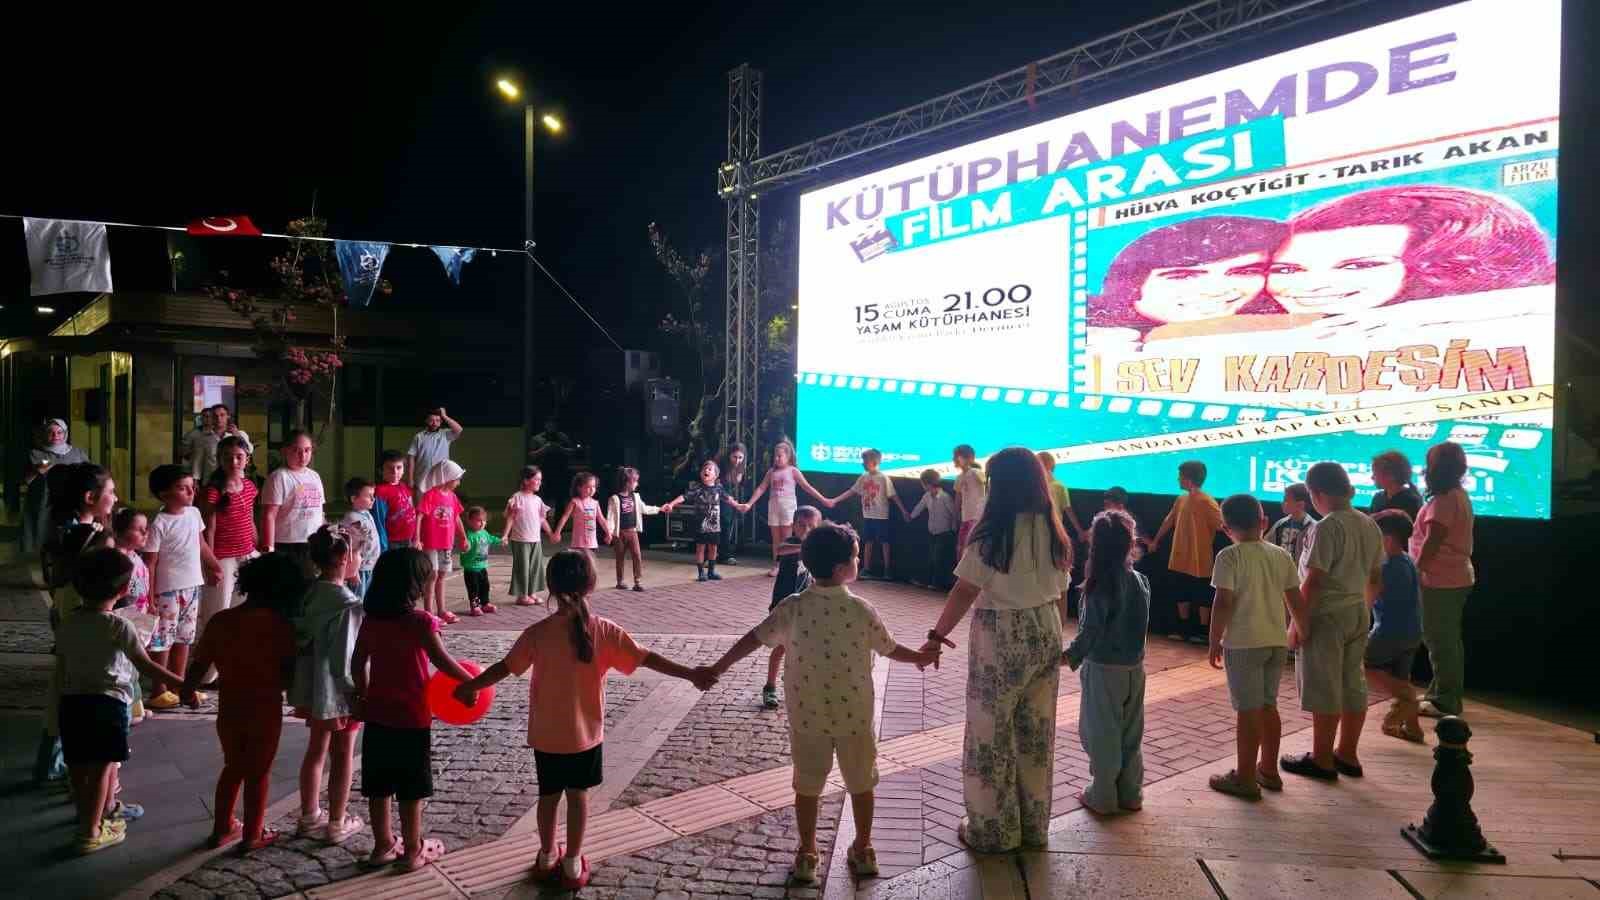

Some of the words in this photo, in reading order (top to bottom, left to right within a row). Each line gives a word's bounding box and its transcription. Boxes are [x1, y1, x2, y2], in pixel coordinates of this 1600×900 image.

[826, 32, 1458, 231] KÜTÜPHANEMDE
[902, 191, 1012, 246] FİLM
[1041, 130, 1254, 214] ARASI
[1115, 198, 1179, 219] HÜLYA
[1333, 151, 1424, 178] TARIK
[1443, 130, 1549, 160] AKAN
[856, 304, 879, 323] 15
[943, 284, 1032, 313] 21.00
[883, 305, 931, 319] CUMA
[856, 322, 902, 335] YAŞAM
[1117, 357, 1200, 393] SEV
[1225, 339, 1534, 395] KARDEŞİM
[1254, 422, 1303, 436] KAP
[1314, 412, 1379, 428] GEL!
